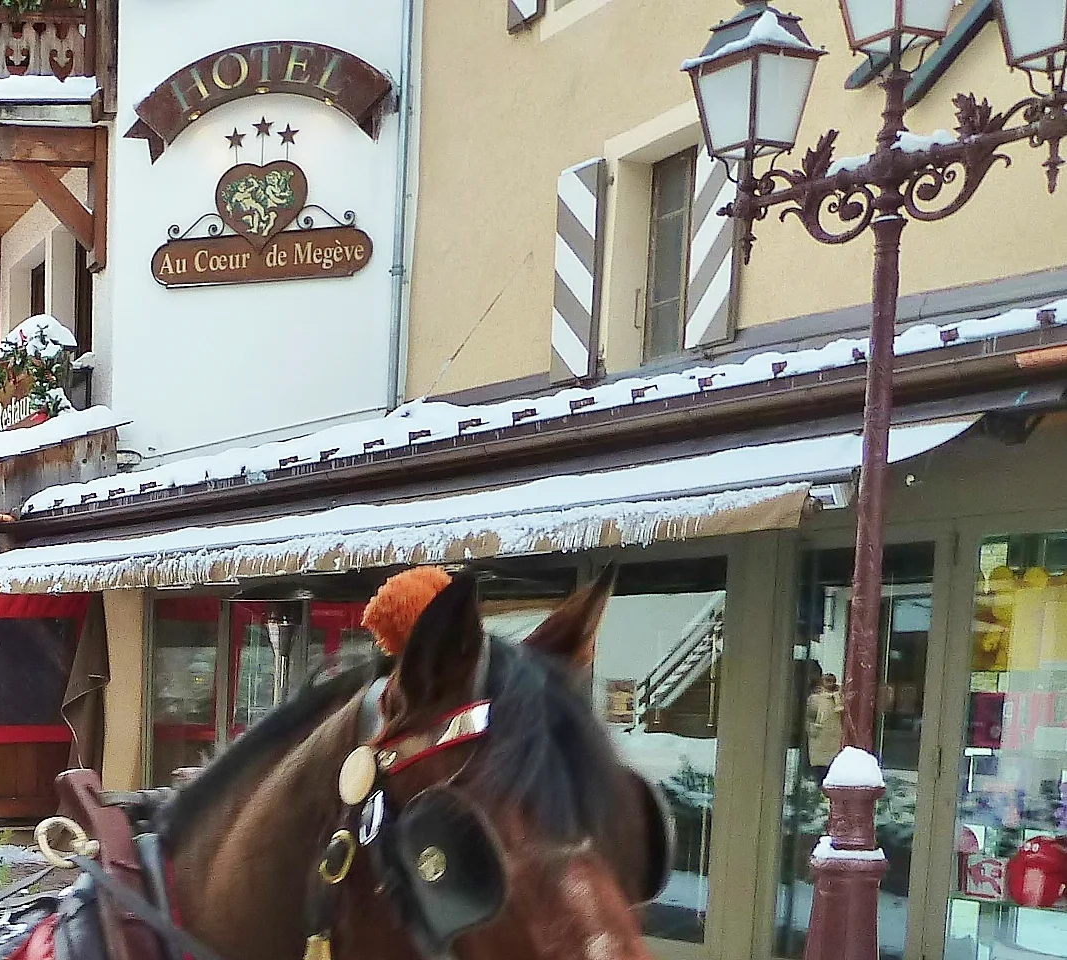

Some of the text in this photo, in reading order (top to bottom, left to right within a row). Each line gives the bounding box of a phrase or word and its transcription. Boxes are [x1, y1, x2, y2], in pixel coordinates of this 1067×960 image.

[170, 44, 344, 111] HOTEL
[160, 239, 365, 275] Au Cœur de Megève
